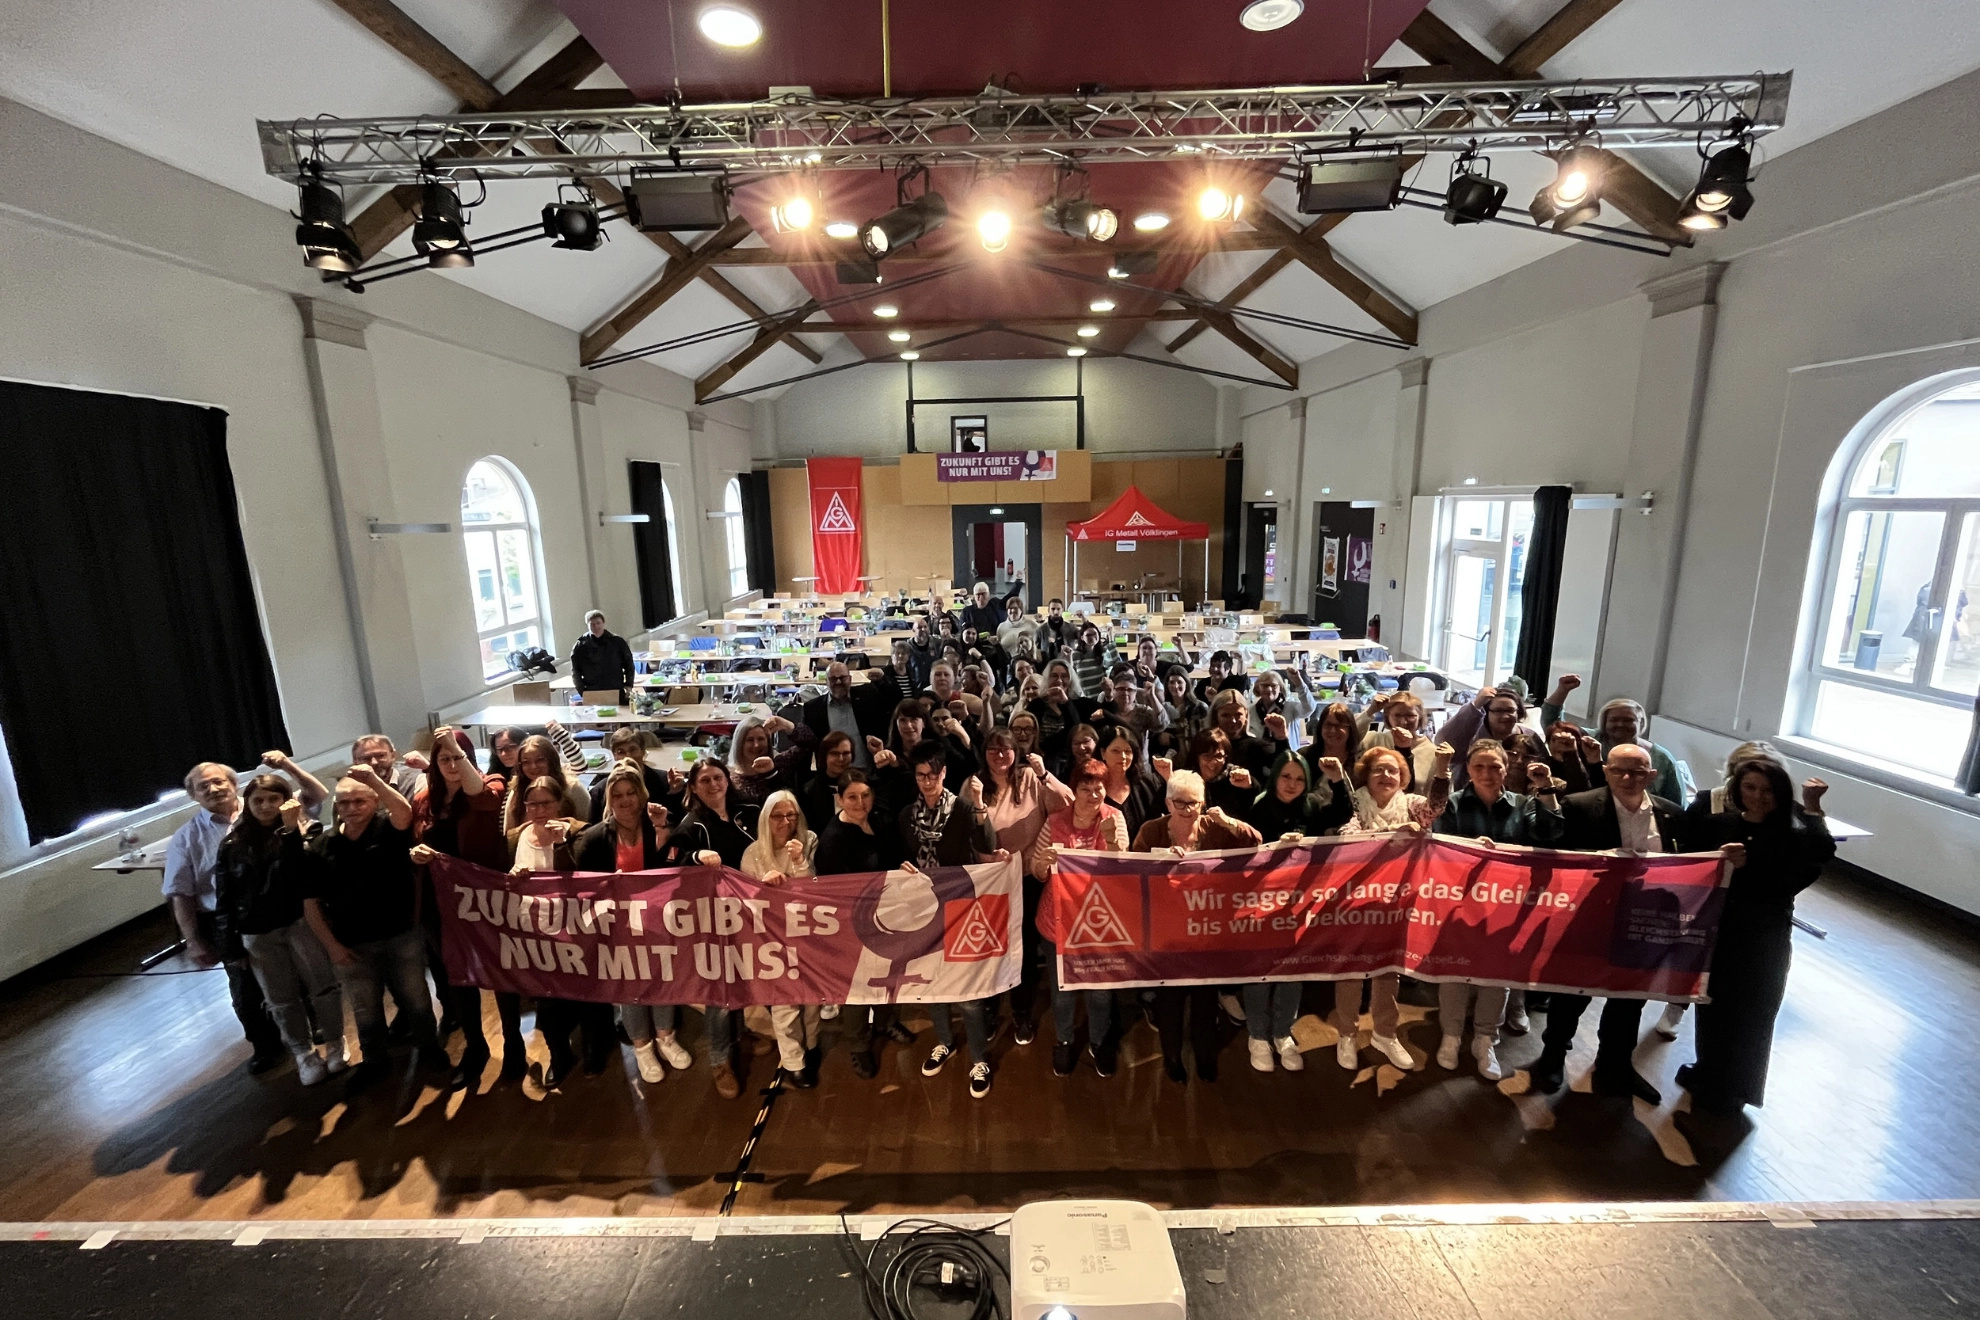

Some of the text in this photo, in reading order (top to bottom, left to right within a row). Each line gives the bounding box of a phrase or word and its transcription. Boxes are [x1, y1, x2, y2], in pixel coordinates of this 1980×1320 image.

[940, 456, 1020, 467] ZUKUNFT GIBT ES
[949, 466, 1012, 477] NUR MIT UNS!
[1104, 529, 1178, 538] IG Metall Völklingen
[1183, 877, 1577, 912] Wir sagen so lange das Gleiche,
[454, 884, 840, 938] ZUKUNFT GIBT ES
[1187, 906, 1443, 936] bis wir es bekommen.
[499, 932, 800, 984] NUR MIT UNS!
